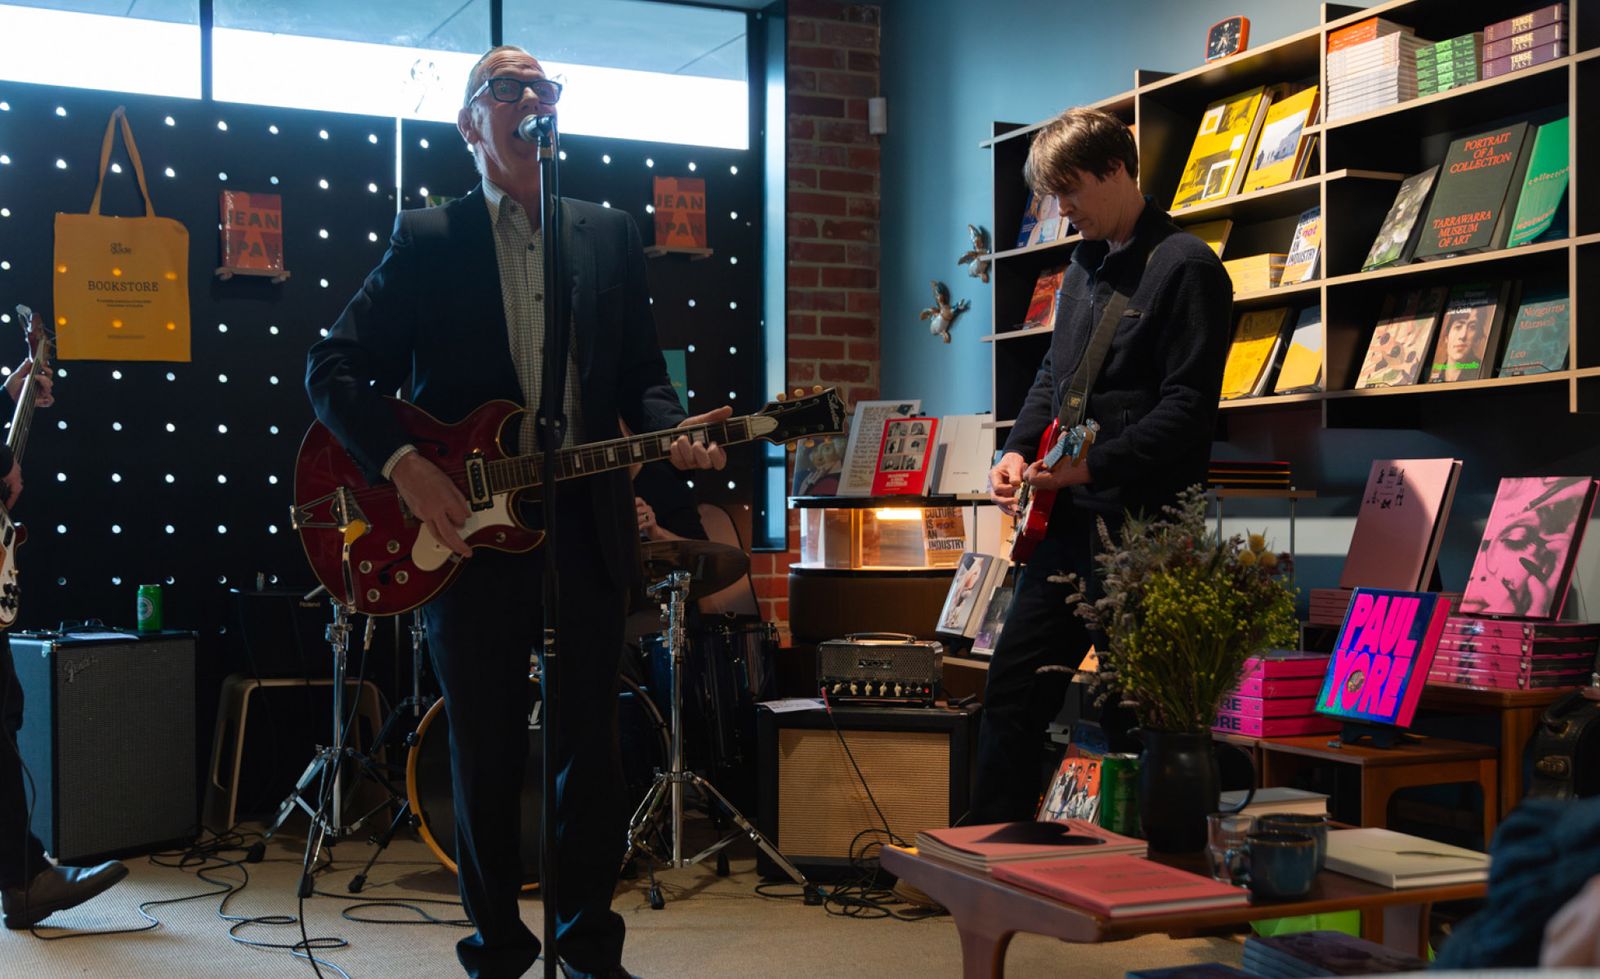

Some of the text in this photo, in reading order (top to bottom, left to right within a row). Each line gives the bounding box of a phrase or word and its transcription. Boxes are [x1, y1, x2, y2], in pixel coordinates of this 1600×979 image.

[1511, 13, 1533, 26] TENSE
[1511, 22, 1531, 34] PAST
[1511, 32, 1533, 45] TENSE
[1511, 42, 1531, 53] PAST
[1511, 50, 1532, 63] TENSE
[1511, 59, 1531, 71] PAST
[1464, 132, 1511, 151] PORTRAIT
[1473, 147, 1494, 159] OF A
[1449, 152, 1512, 174] COLLECTION
[1433, 210, 1492, 229] TARRAWARRA
[1302, 224, 1318, 237] not
[1438, 222, 1478, 238] MUSEUM
[1438, 234, 1472, 248] OF ART
[1288, 248, 1315, 265] INDUSTRY
[87, 280, 159, 292] BOOKSTORE
[925, 507, 956, 519] CULTURE
[926, 519, 954, 529] IS not
[927, 530, 938, 539] AN
[928, 540, 964, 550] INDUSTRY
[1340, 593, 1420, 655] PAUL
[1325, 648, 1412, 717] YORE
